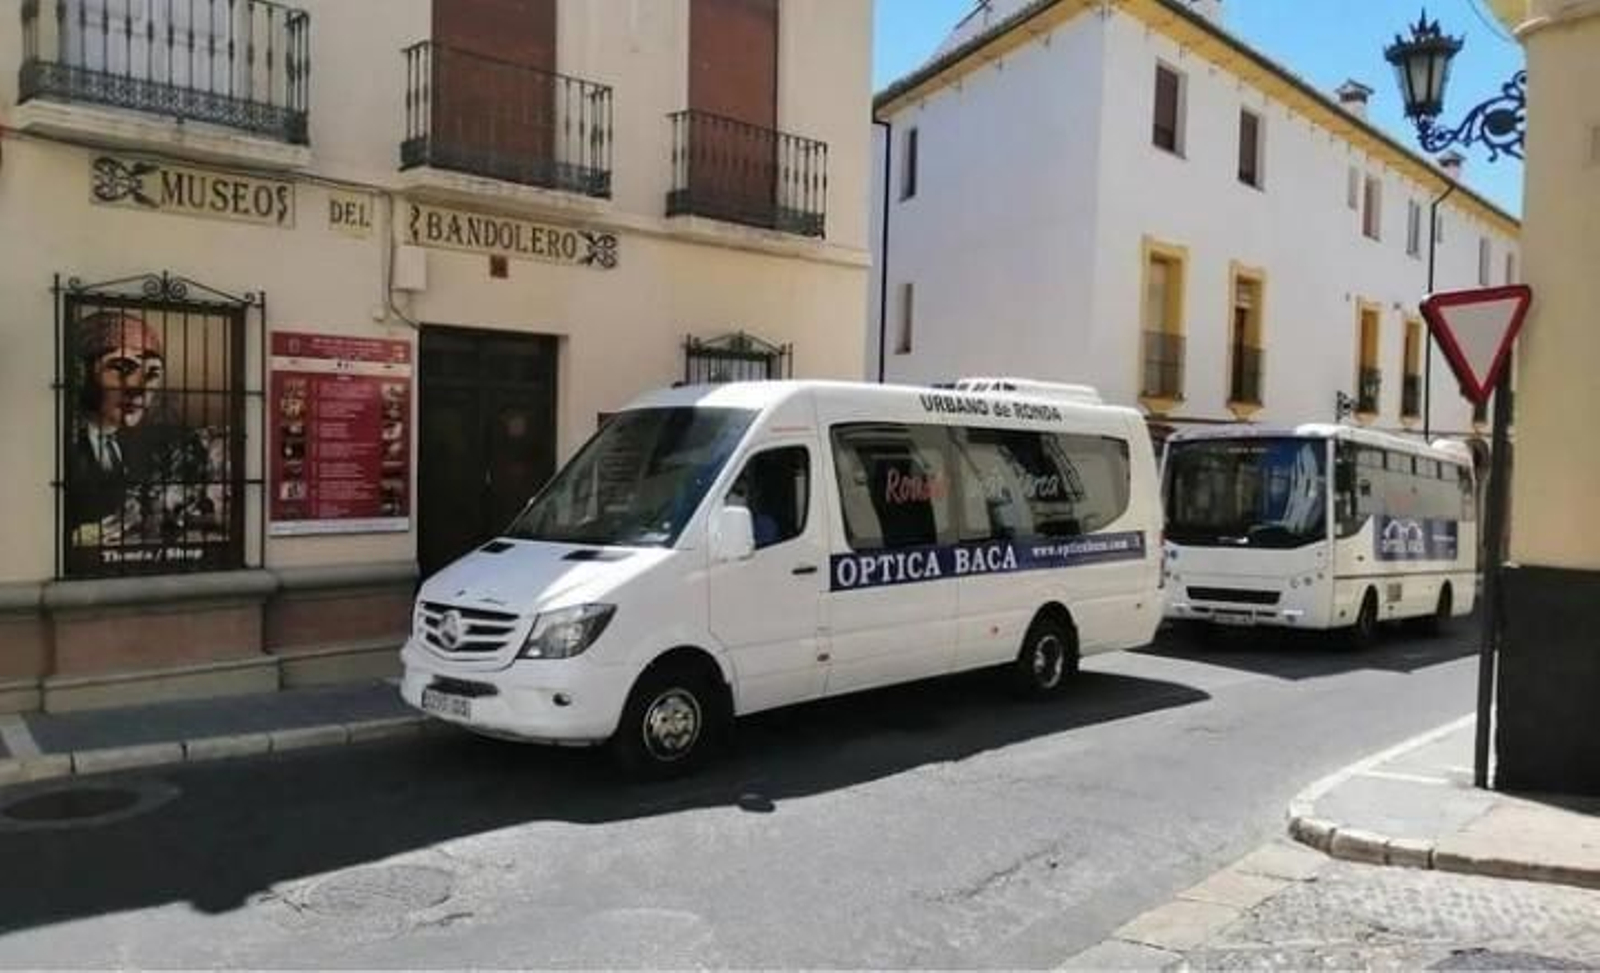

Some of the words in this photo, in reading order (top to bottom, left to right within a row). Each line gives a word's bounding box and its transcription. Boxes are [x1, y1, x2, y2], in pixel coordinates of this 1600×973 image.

[160, 170, 273, 217] MUSEO
[329, 199, 371, 227] DEL
[426, 211, 577, 259] BANDOLERO
[919, 394, 989, 415] URBANO
[993, 402, 1012, 418] de
[1013, 402, 1062, 422] RONDA
[837, 551, 941, 587] OPTICA
[954, 545, 1018, 572] BACA
